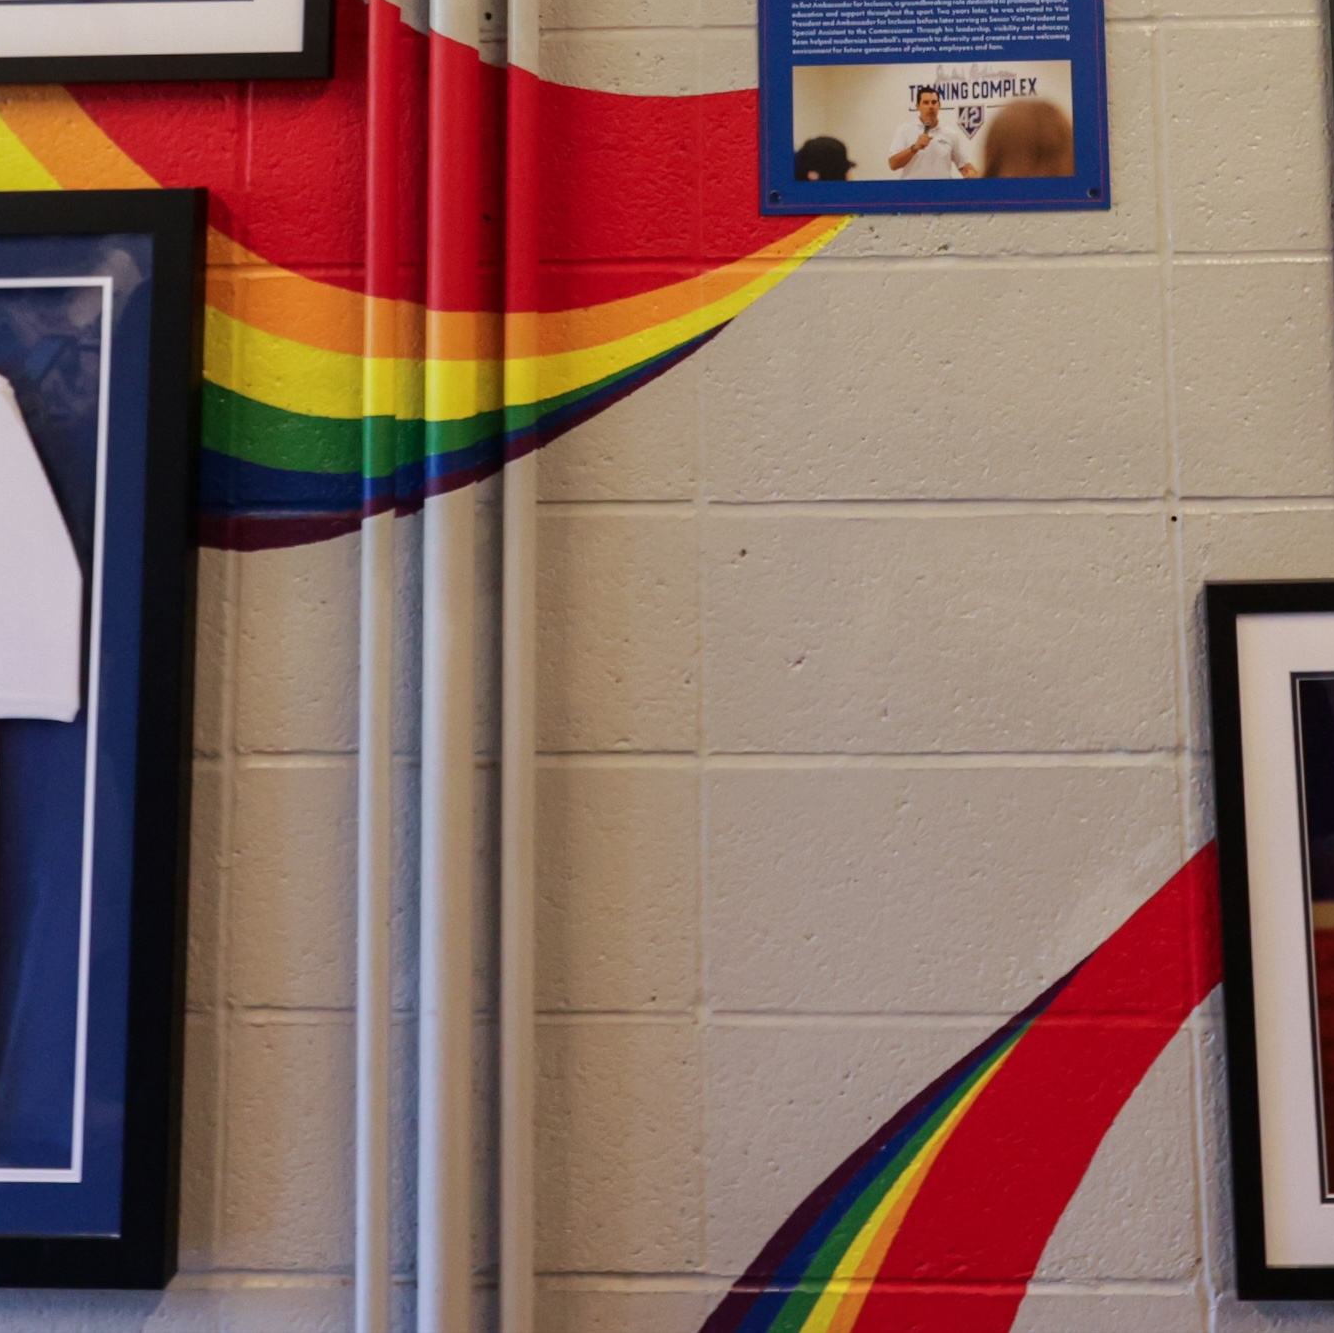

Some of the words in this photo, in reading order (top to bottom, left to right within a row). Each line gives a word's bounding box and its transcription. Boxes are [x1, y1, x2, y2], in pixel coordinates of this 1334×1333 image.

[864, 45, 902, 54] generations
[939, 44, 973, 53] employees
[972, 77, 1038, 99] COMPLEX
[959, 106, 981, 128] 42
